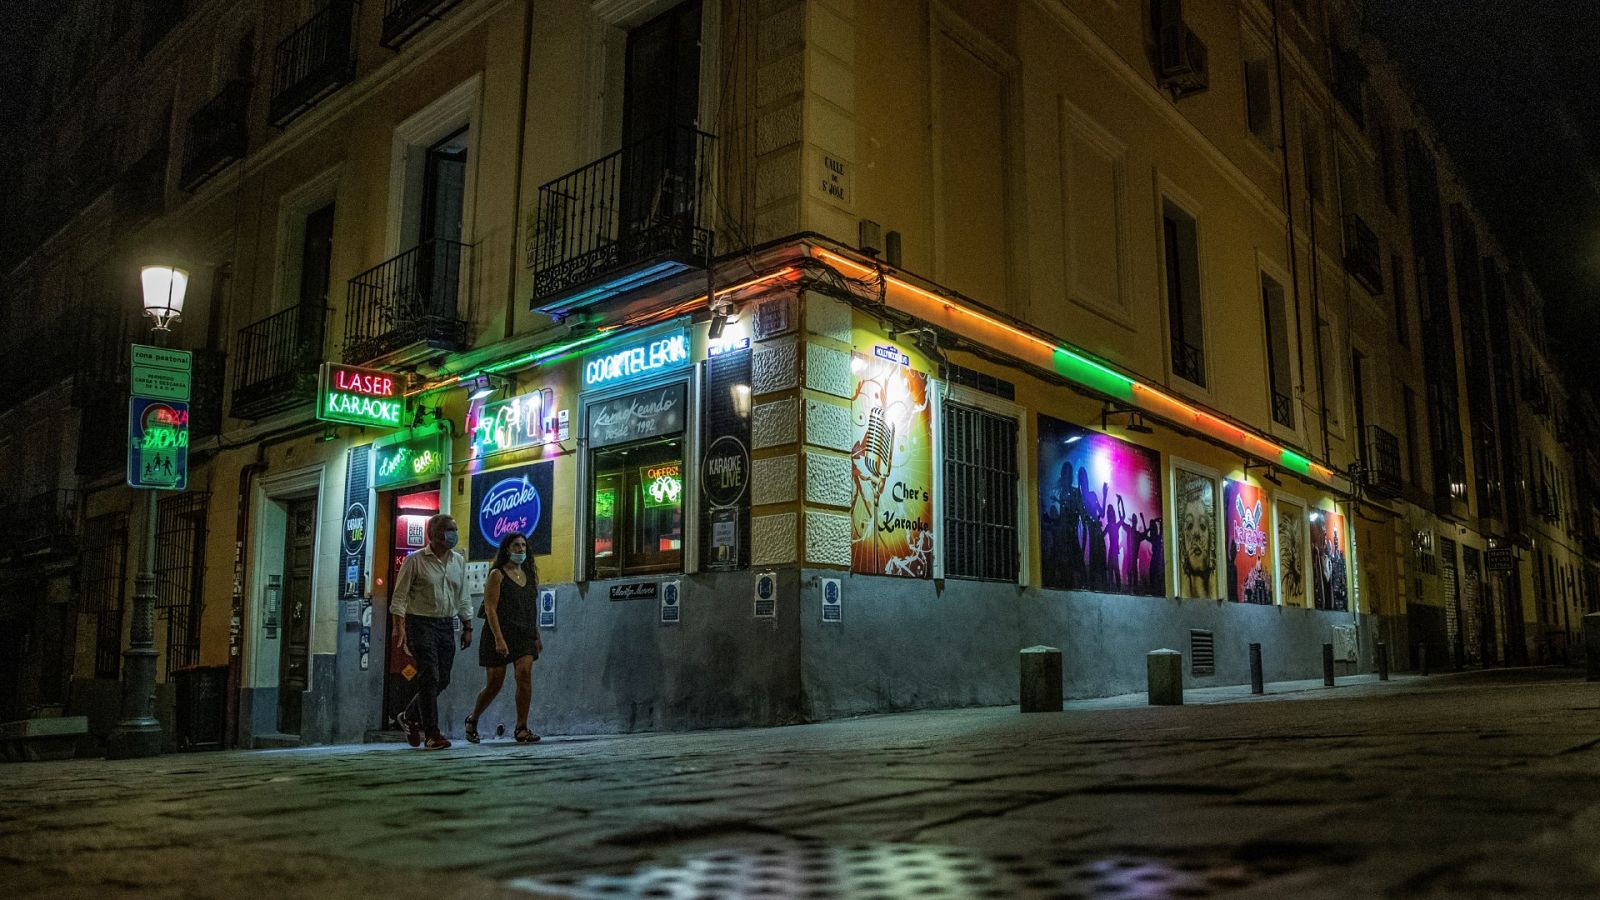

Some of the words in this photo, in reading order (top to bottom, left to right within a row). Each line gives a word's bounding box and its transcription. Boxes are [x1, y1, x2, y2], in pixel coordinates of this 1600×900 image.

[824, 156, 844, 176] CALLE
[155, 355, 188, 364] peatonal
[338, 370, 393, 396] LASER
[328, 393, 401, 422] KARAOKE
[413, 450, 433, 473] BAR
[709, 455, 741, 476] KARAOKE
[721, 470, 742, 489] LIVE
[482, 476, 536, 519] Karaoke
[878, 511, 929, 533] Karaoke
